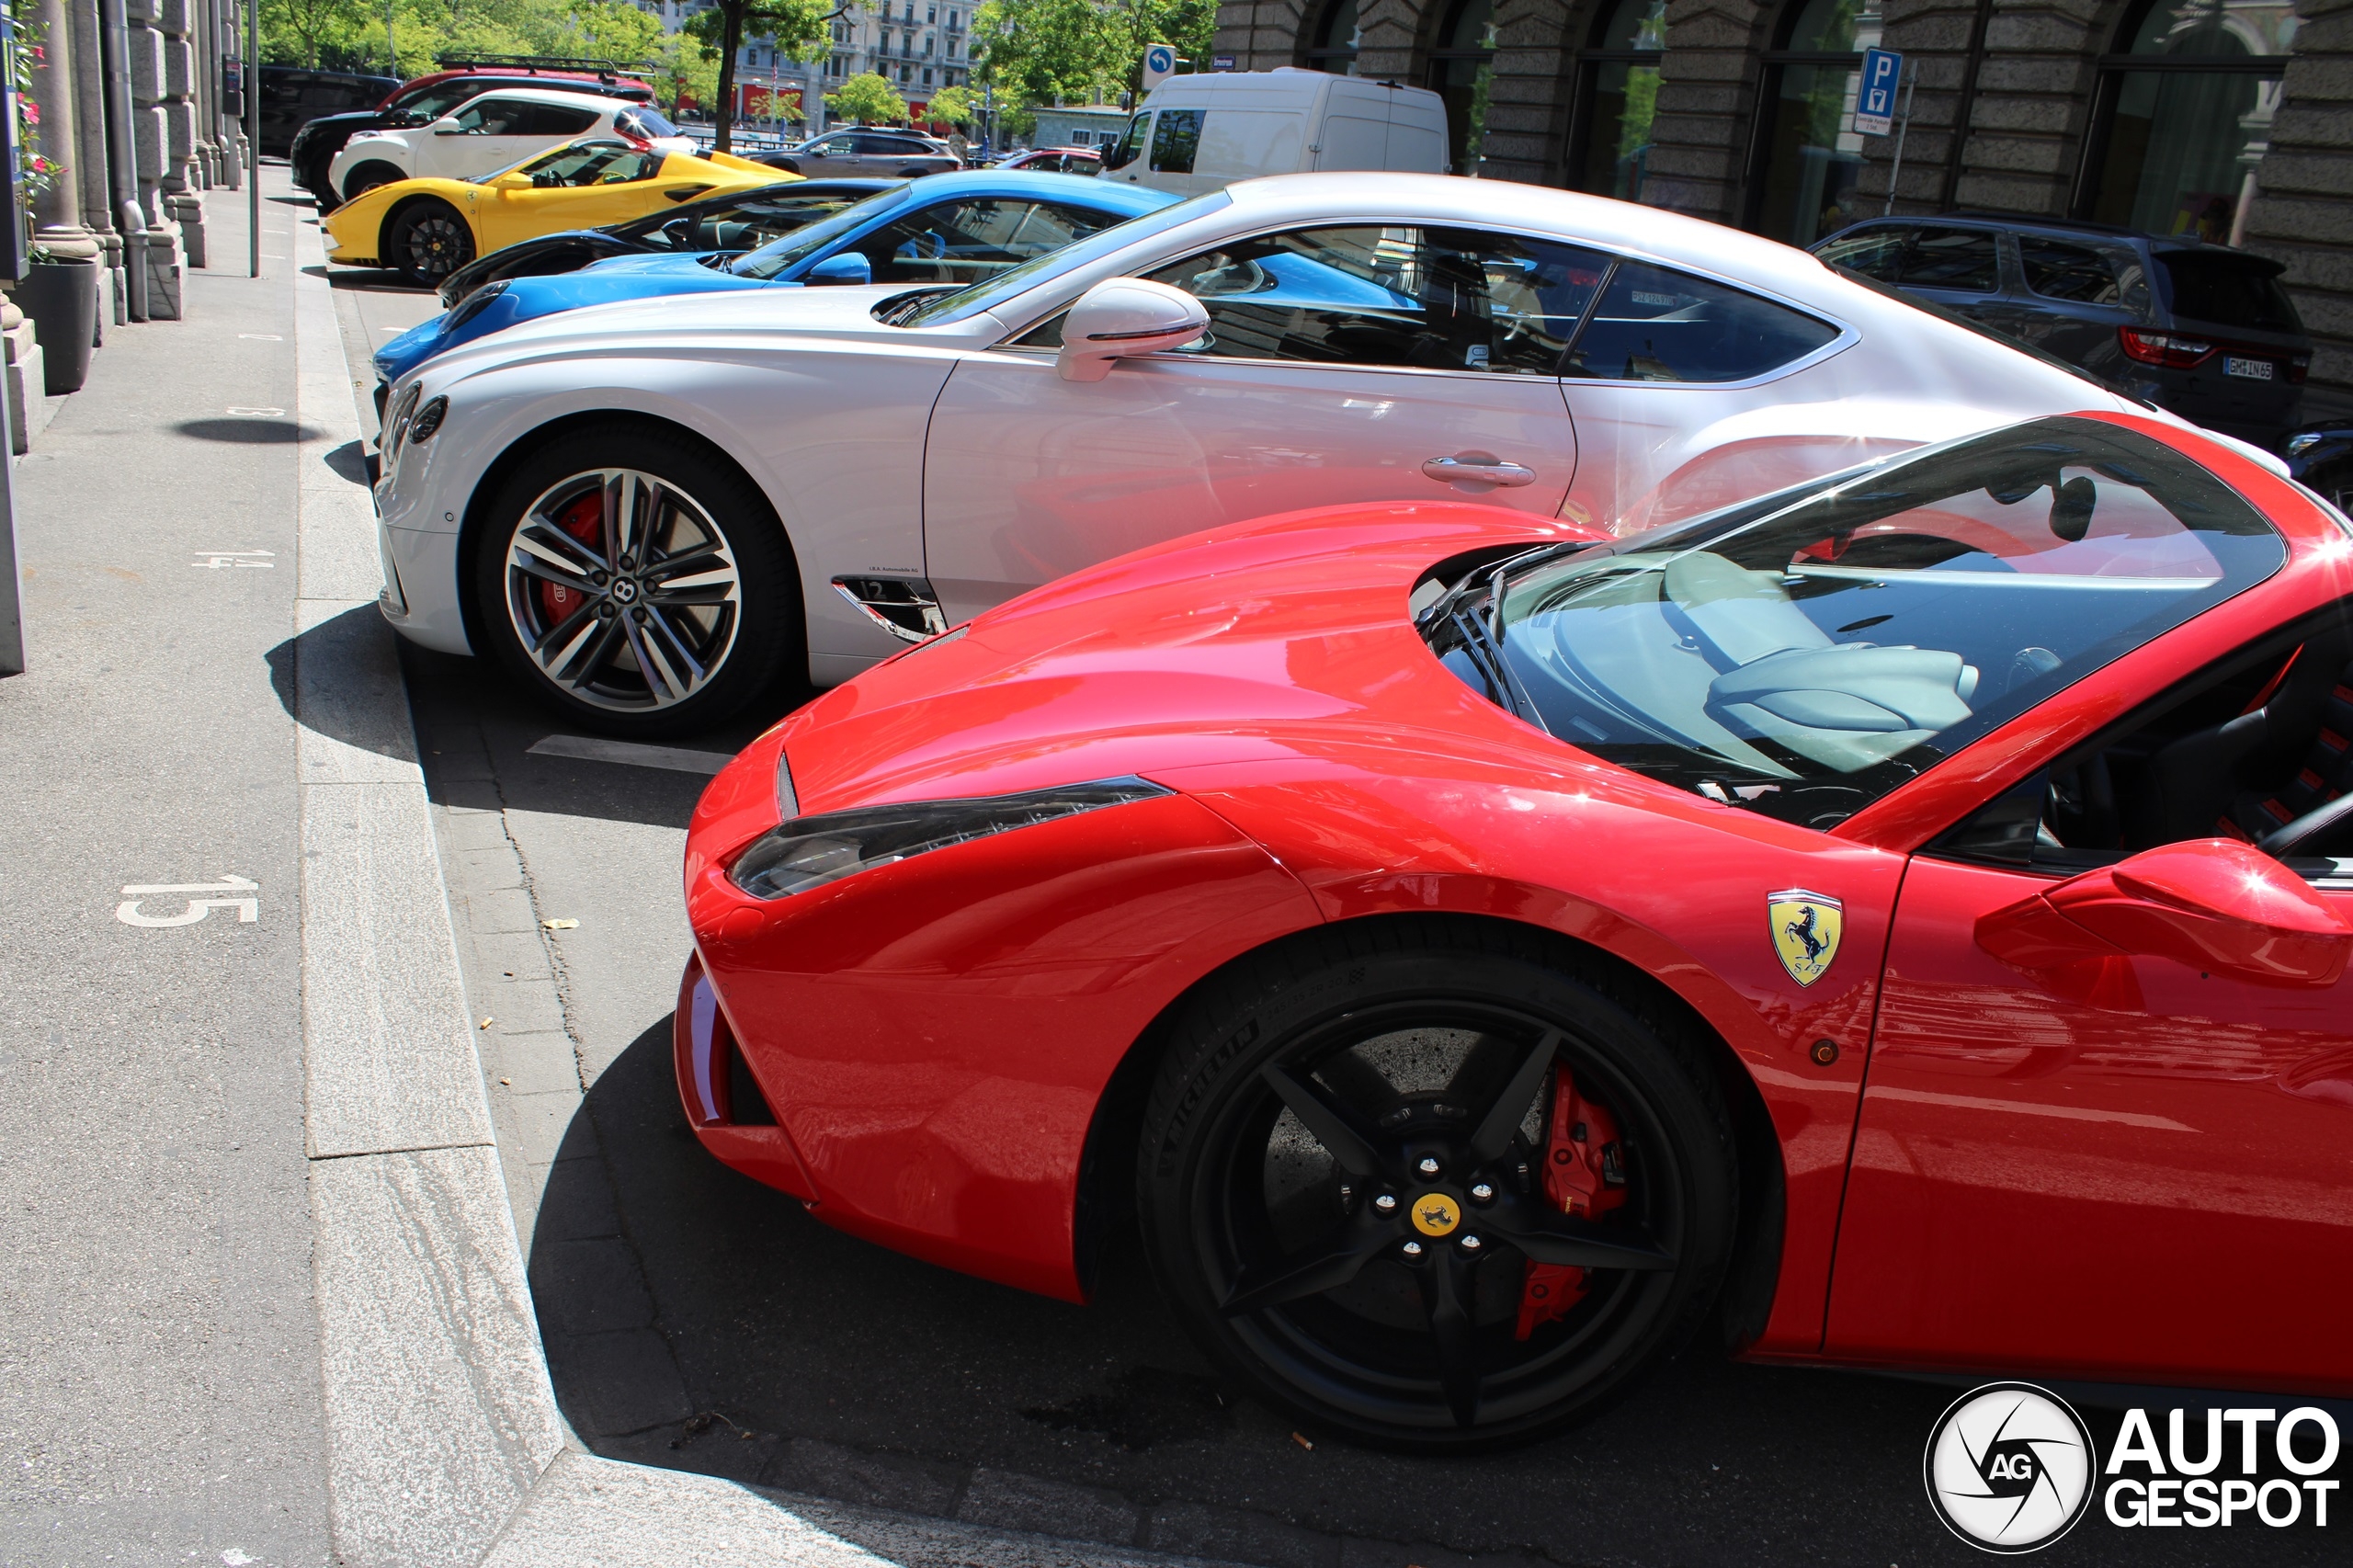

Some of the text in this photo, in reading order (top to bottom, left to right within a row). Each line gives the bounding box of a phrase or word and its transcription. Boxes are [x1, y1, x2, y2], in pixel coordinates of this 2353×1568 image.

[1873, 56, 1893, 86] P
[226, 406, 287, 417] 13
[190, 549, 276, 570] 14
[613, 580, 635, 603] B
[115, 873, 259, 928] 15
[1168, 1023, 1253, 1144] MICHELIN
